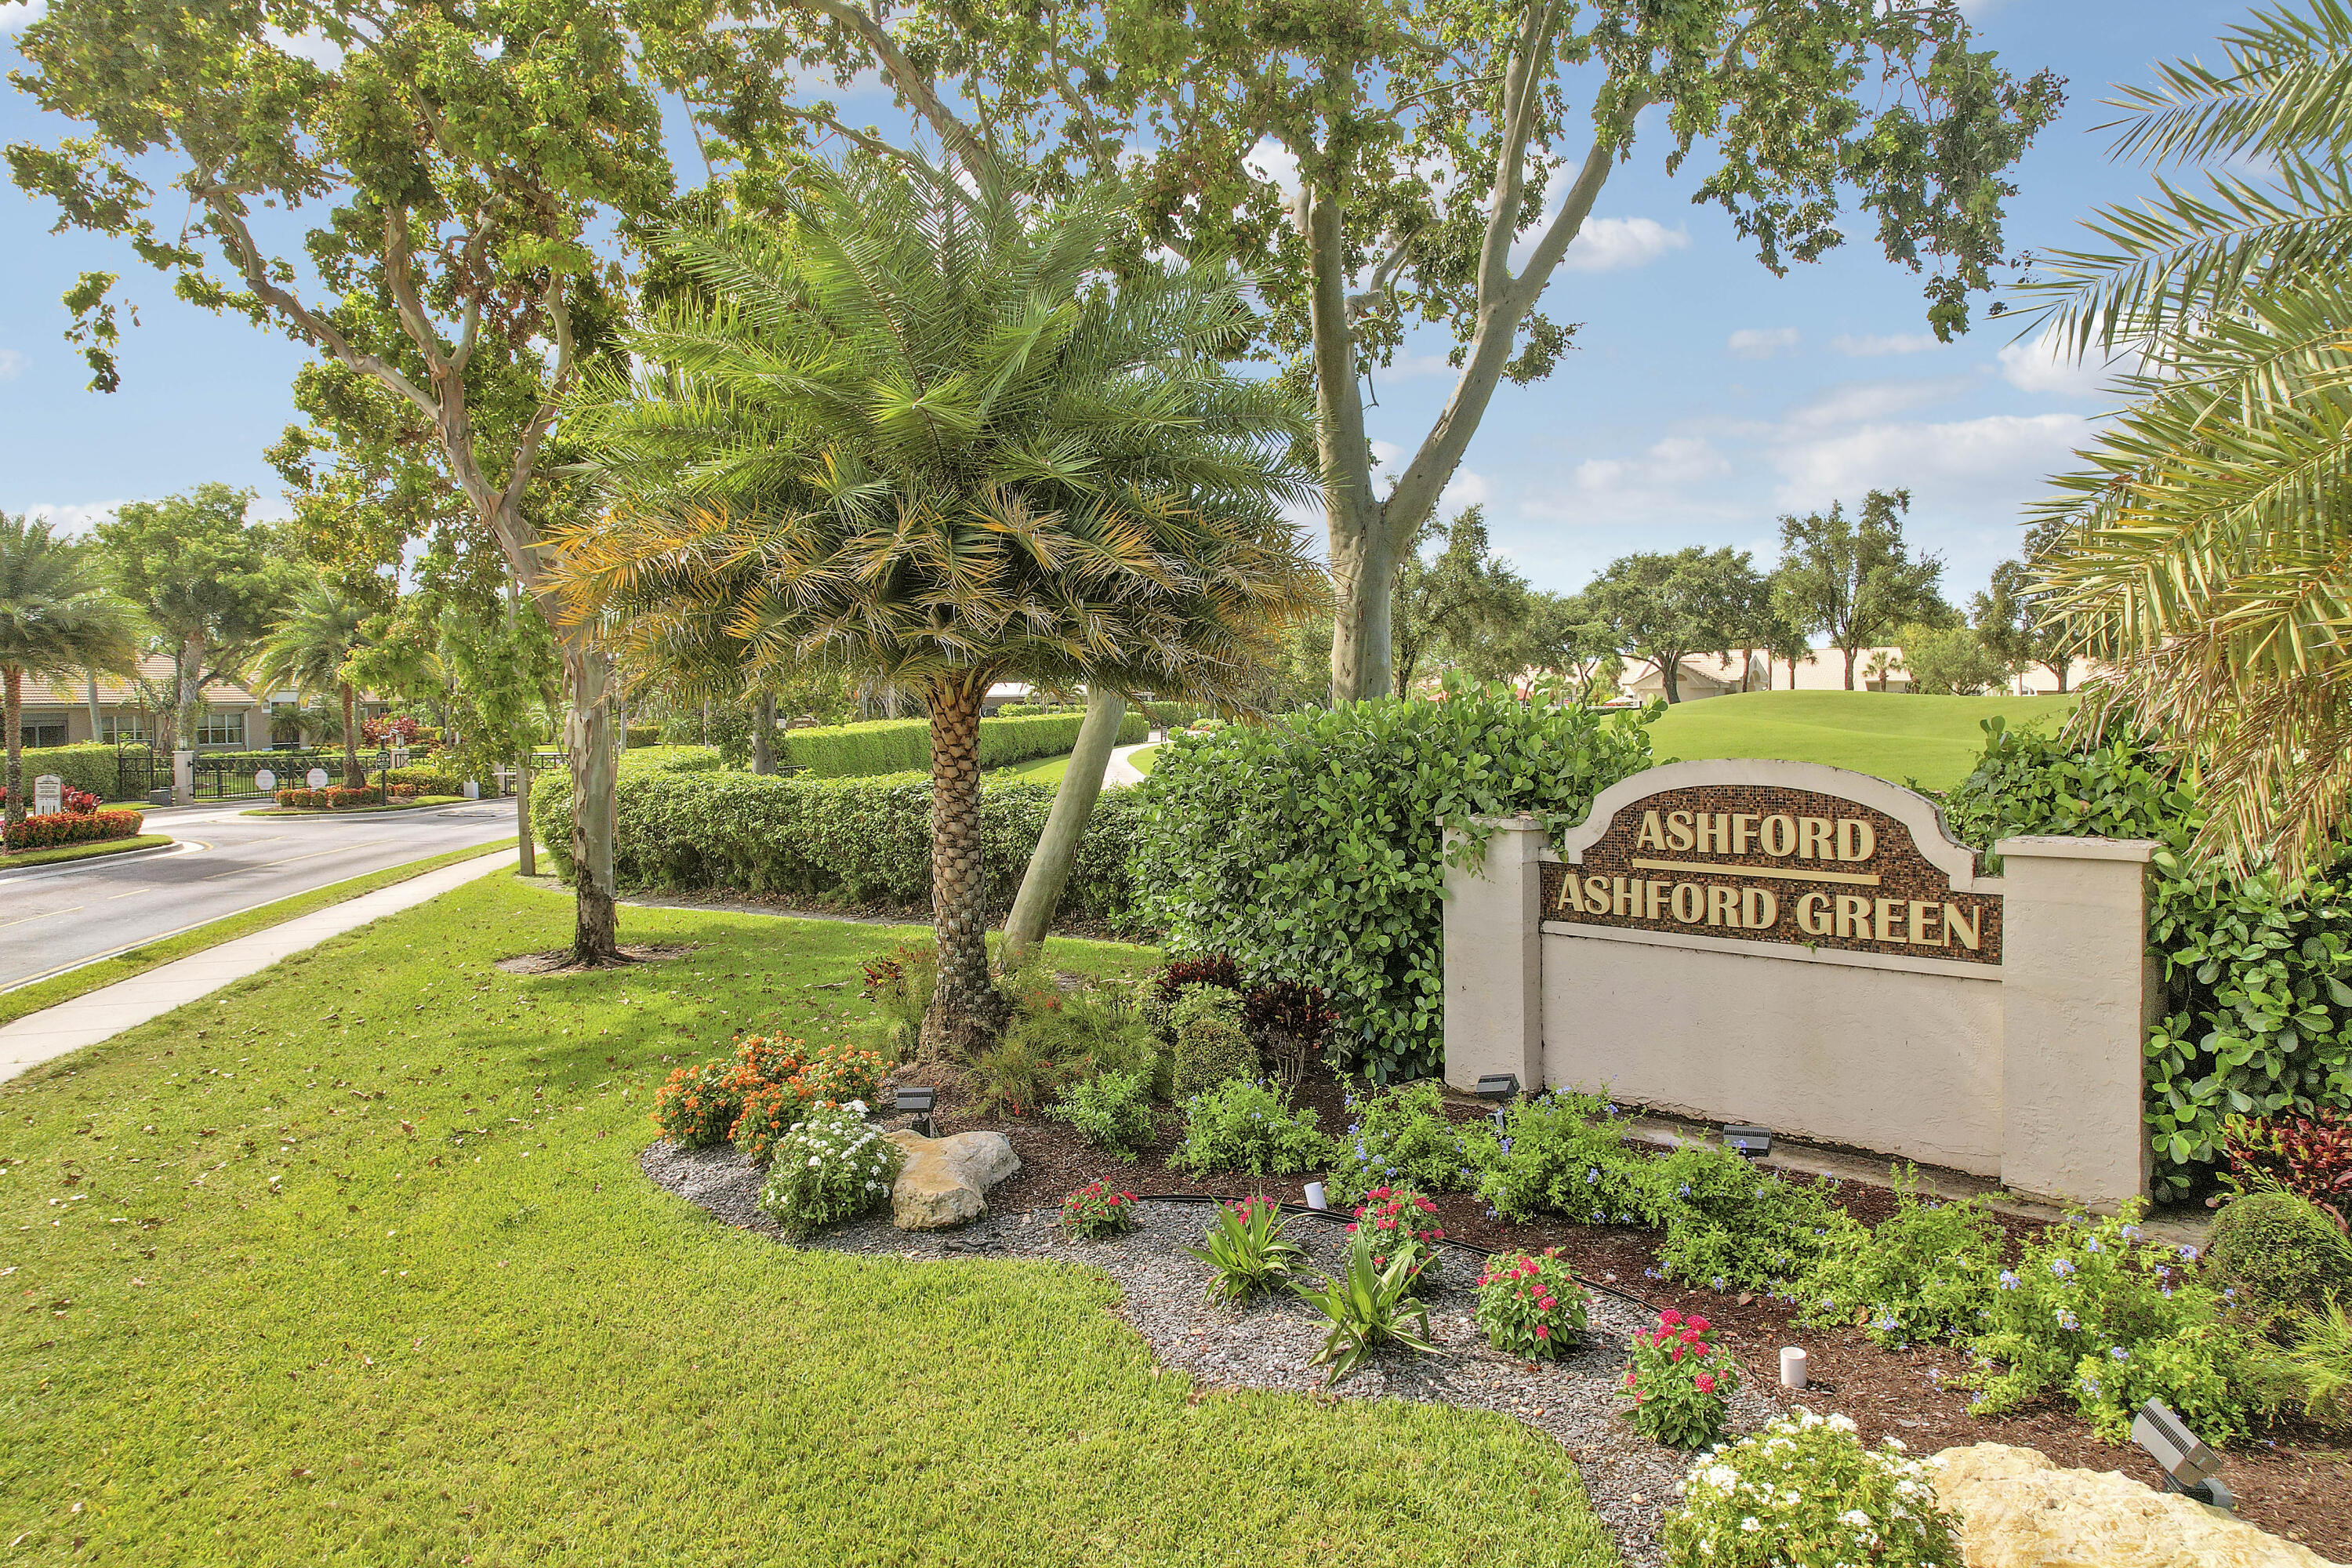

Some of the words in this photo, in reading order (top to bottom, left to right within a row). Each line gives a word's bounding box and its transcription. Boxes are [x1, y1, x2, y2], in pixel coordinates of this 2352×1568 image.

[1636, 810, 1876, 862] ASHFORD
[1557, 873, 1778, 929] ASHFORD
[1796, 892, 1980, 950] GREEN
